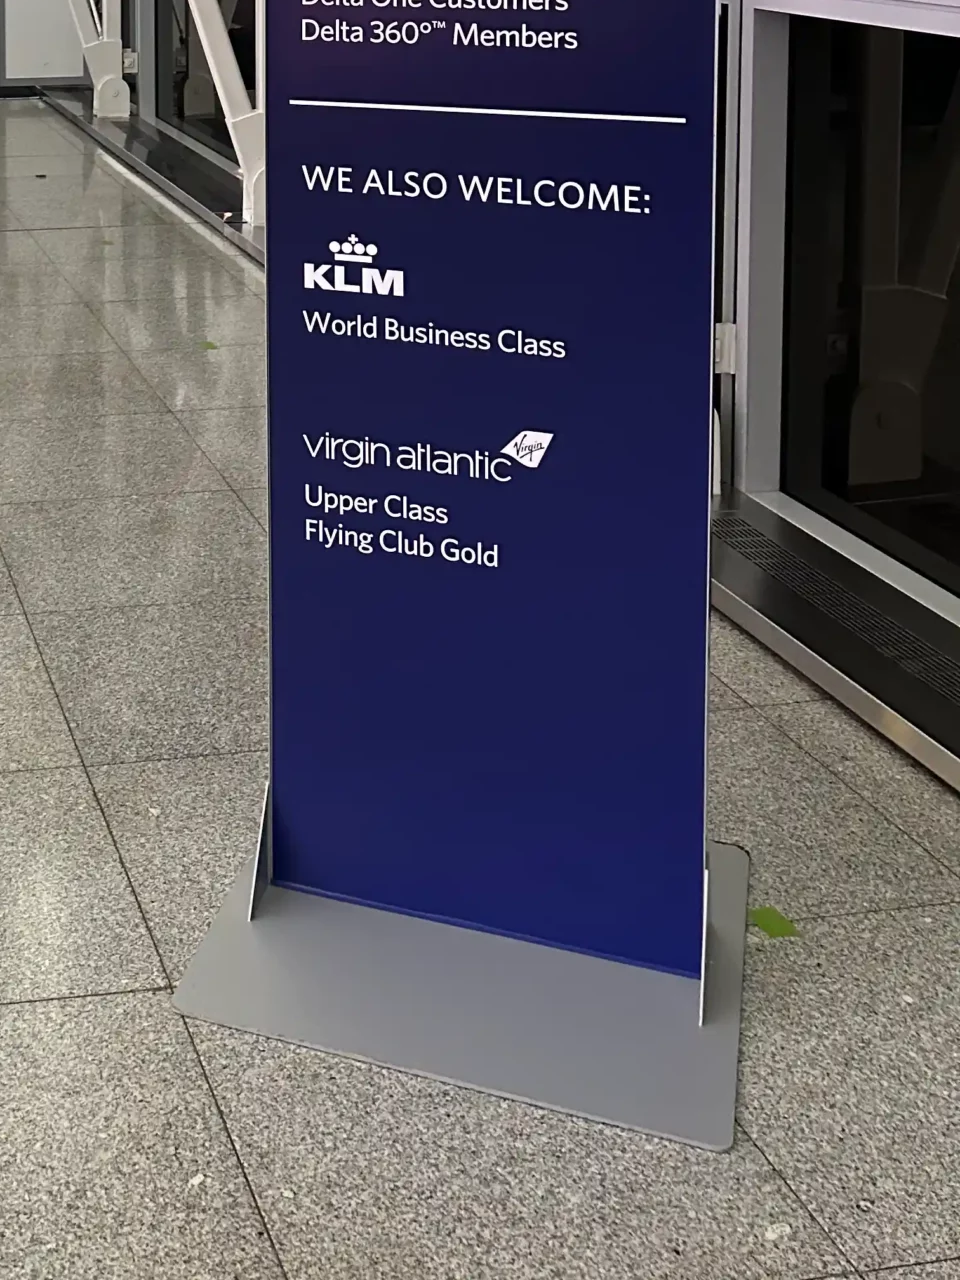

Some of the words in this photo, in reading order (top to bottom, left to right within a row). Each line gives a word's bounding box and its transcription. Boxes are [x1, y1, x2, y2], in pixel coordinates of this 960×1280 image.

[301, 19, 364, 43] Delta
[452, 22, 579, 49] Members
[301, 164, 354, 193] WE
[362, 169, 448, 199] ALSO
[458, 175, 651, 214] WELCOME:
[303, 263, 404, 297] KLM
[302, 310, 377, 339] World
[384, 317, 491, 350] Business
[497, 329, 566, 358] Class
[302, 431, 390, 468] virgin
[396, 442, 512, 482] atlantic
[304, 483, 378, 515] Upper
[384, 494, 449, 524] Class
[305, 519, 373, 554] Flying
[379, 529, 434, 557] Club
[440, 538, 499, 568] Gold
